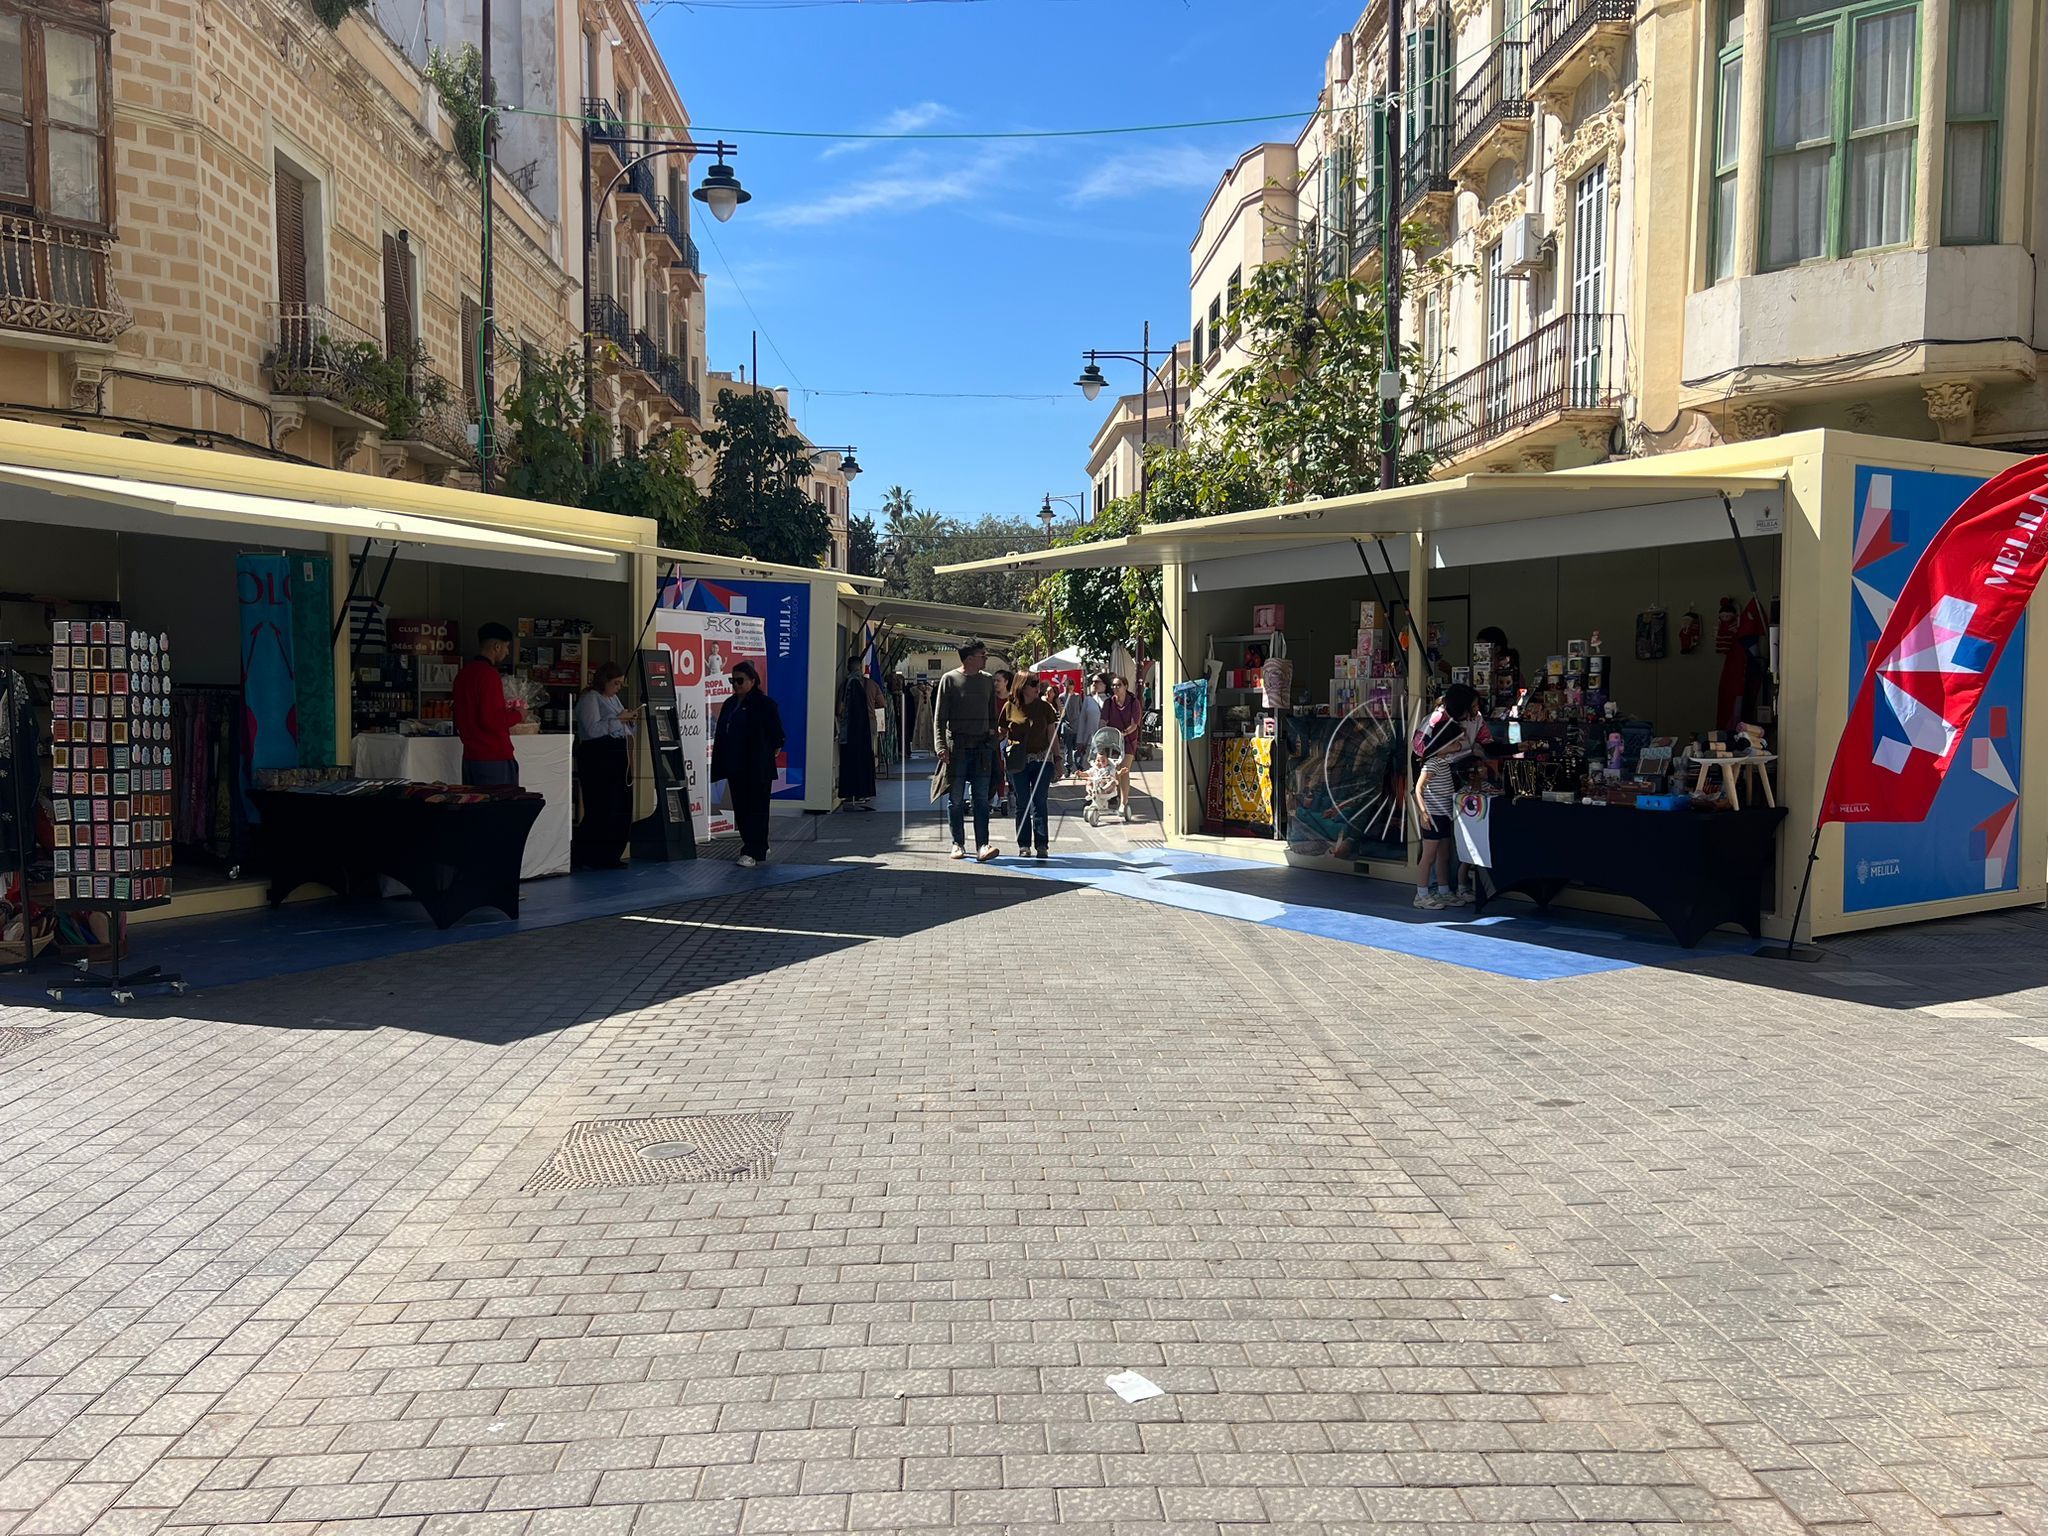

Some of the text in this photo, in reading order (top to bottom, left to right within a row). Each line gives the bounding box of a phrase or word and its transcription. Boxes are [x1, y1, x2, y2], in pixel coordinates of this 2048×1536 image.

[779, 596, 791, 657] MELILLA
[430, 640, 455, 652] 100
[705, 680, 723, 689] ROPA
[1870, 864, 1900, 877] MELILLA
